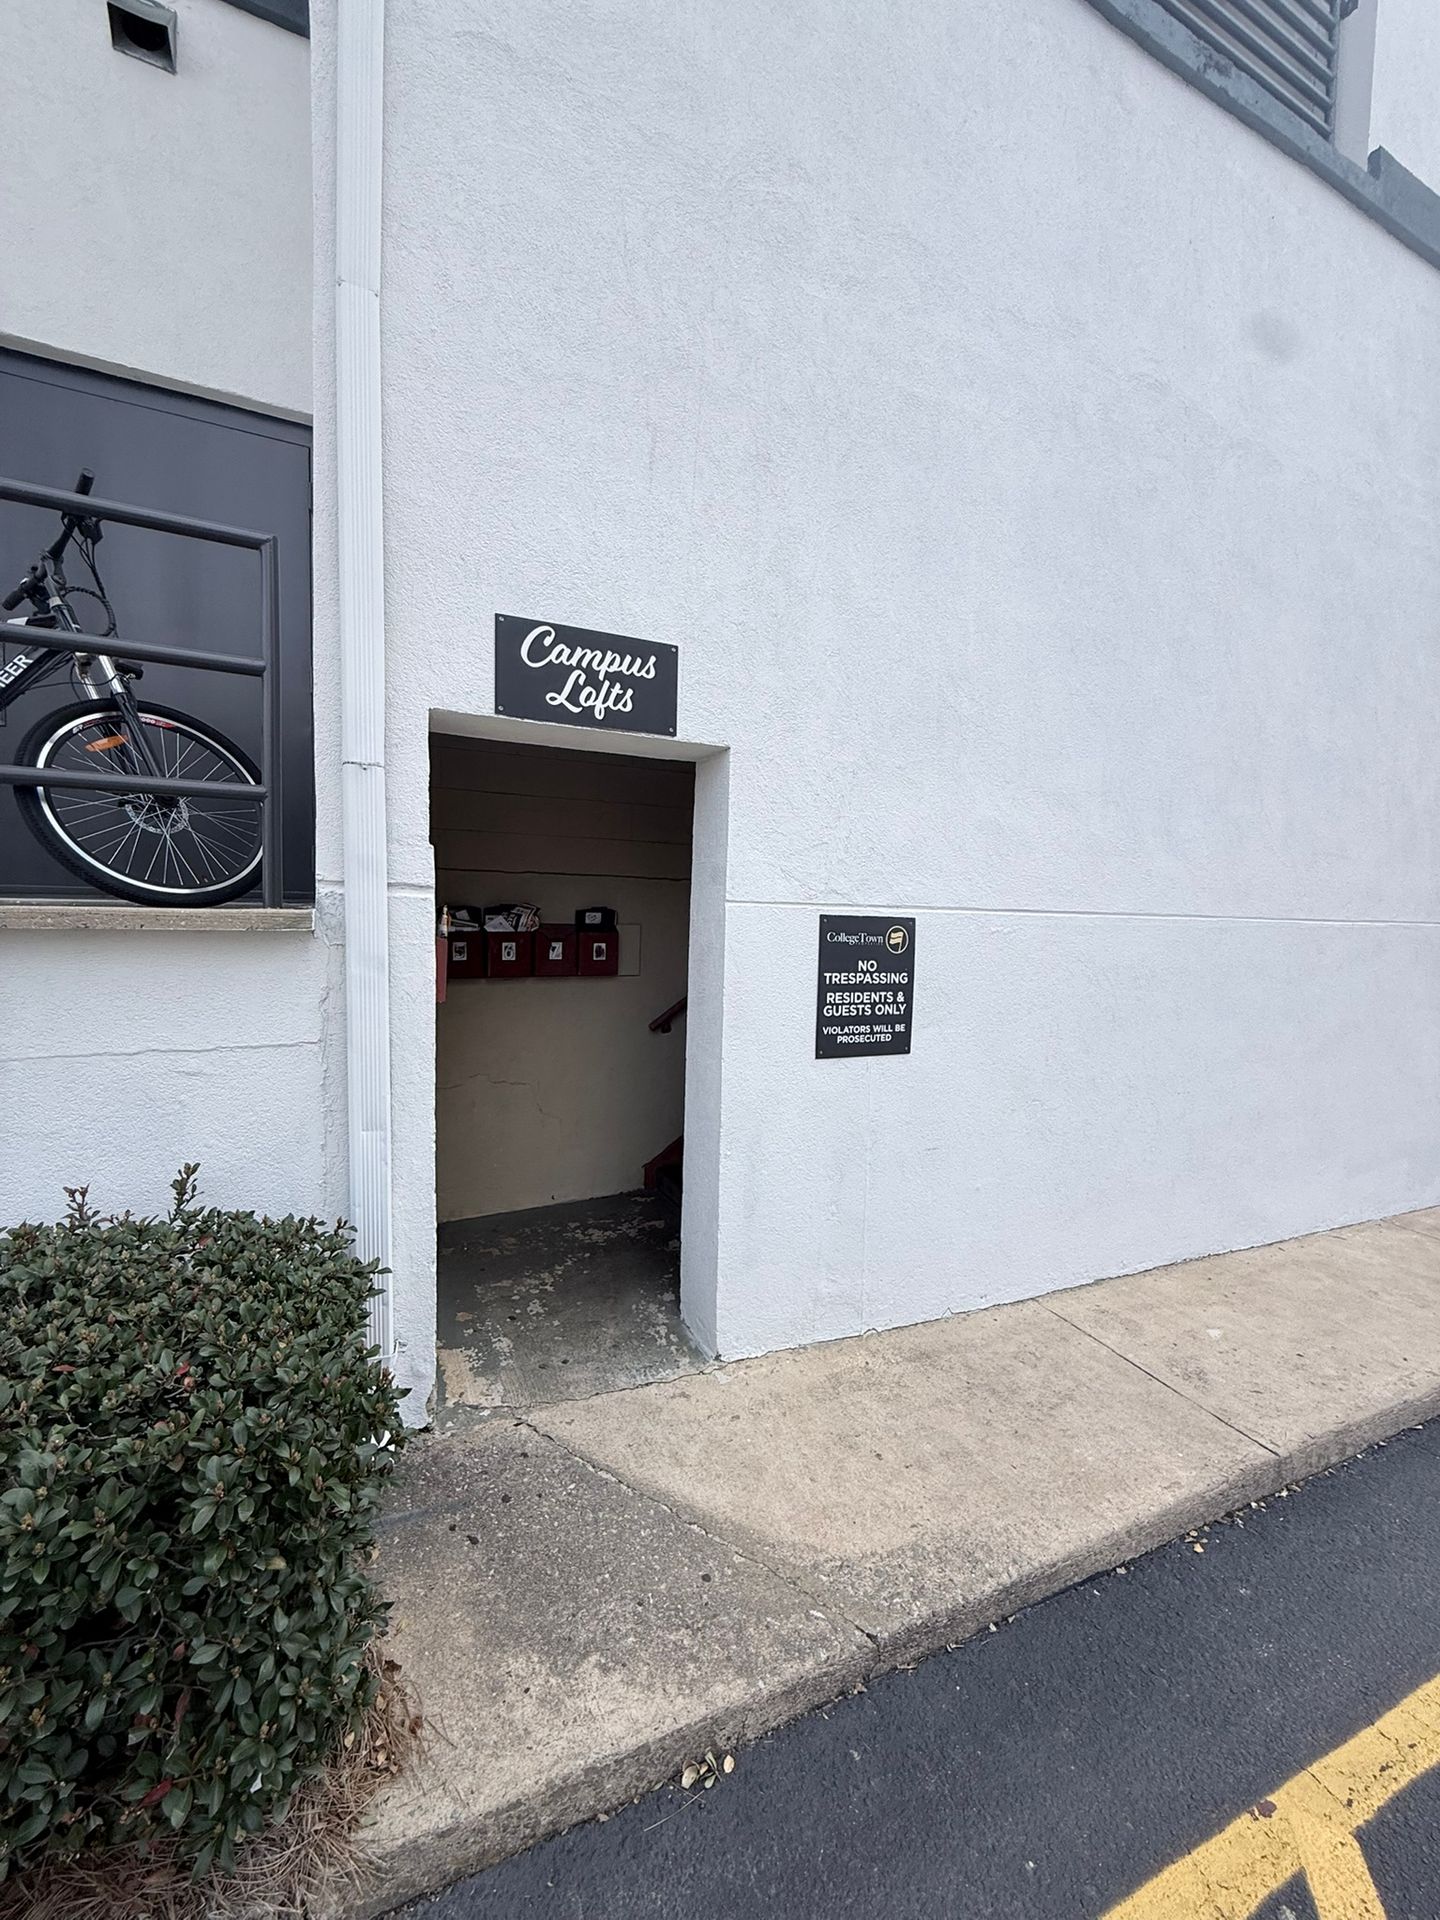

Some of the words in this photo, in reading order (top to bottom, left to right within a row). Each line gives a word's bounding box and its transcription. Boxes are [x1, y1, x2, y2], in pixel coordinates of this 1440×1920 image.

[520, 625, 657, 681] Campus
[0, 654, 34, 688] EER
[545, 669, 634, 720] Lofts
[826, 931, 884, 945] CollegeTown
[857, 960, 878, 972] NO
[823, 972, 909, 985] TRESPASSING
[826, 992, 894, 1004] RESIDENTS
[896, 991, 905, 1003] &
[823, 1004, 872, 1017] GUESTS
[874, 1003, 907, 1015] ONLY
[822, 1025, 871, 1035] VIOLATORS
[872, 1024, 893, 1033] WILL
[895, 1024, 906, 1032] BE
[836, 1033, 892, 1044] PROSECUTED
